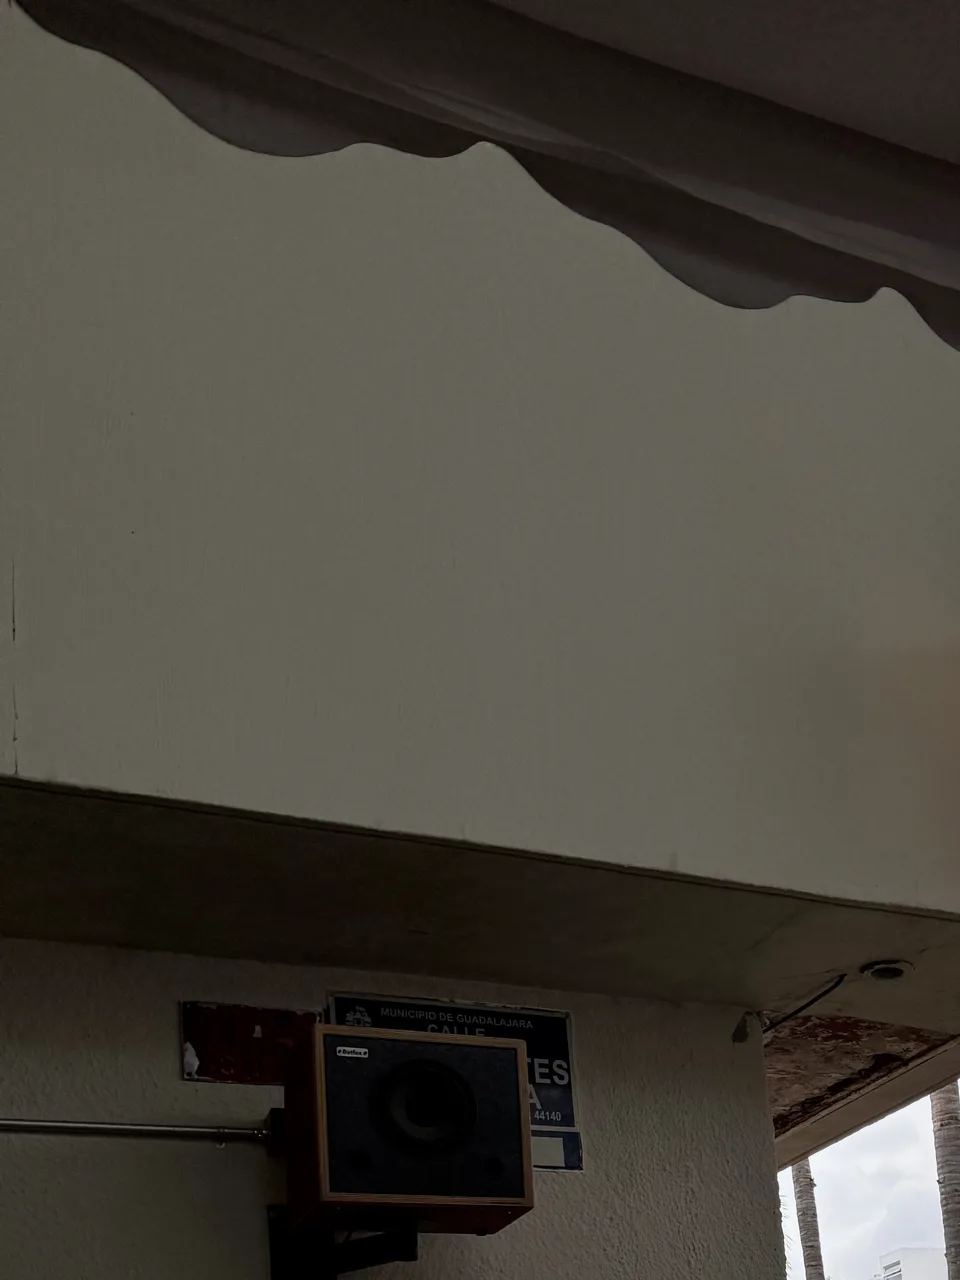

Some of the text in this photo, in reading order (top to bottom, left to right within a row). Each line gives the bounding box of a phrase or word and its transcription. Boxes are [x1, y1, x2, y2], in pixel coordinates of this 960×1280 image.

[380, 1006, 534, 1029] MUNICIPIO DE GUADALAJARA
[527, 1057, 570, 1086] ES
[534, 1110, 562, 1122] 44140
